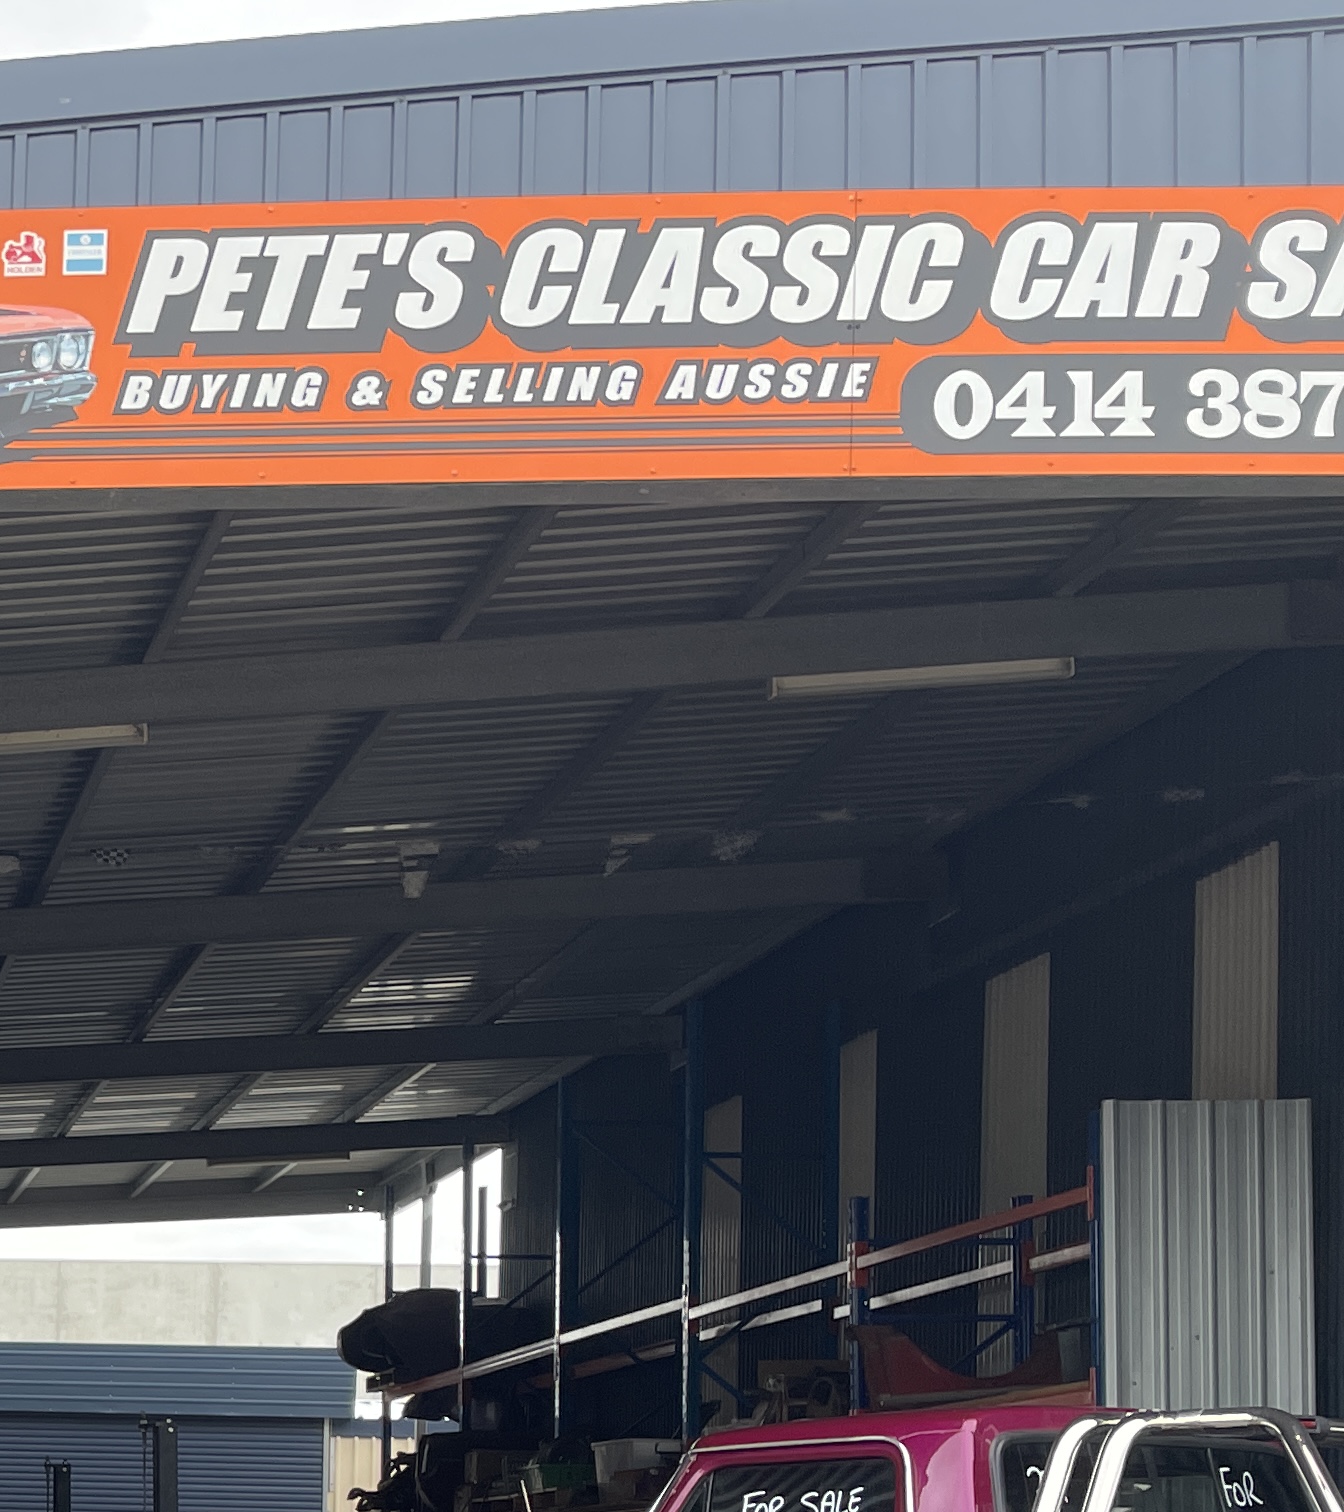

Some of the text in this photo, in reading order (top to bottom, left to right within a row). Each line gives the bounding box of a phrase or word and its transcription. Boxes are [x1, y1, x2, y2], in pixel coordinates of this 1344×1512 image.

[126, 230, 476, 335] PETE'S
[500, 222, 966, 328] CLASSIC
[990, 220, 1222, 320] CAR
[120, 362, 874, 411] BUYING & SELLING AUSSIE
[933, 367, 1344, 440] 0414 387
[1218, 1467, 1263, 1507] FOR
